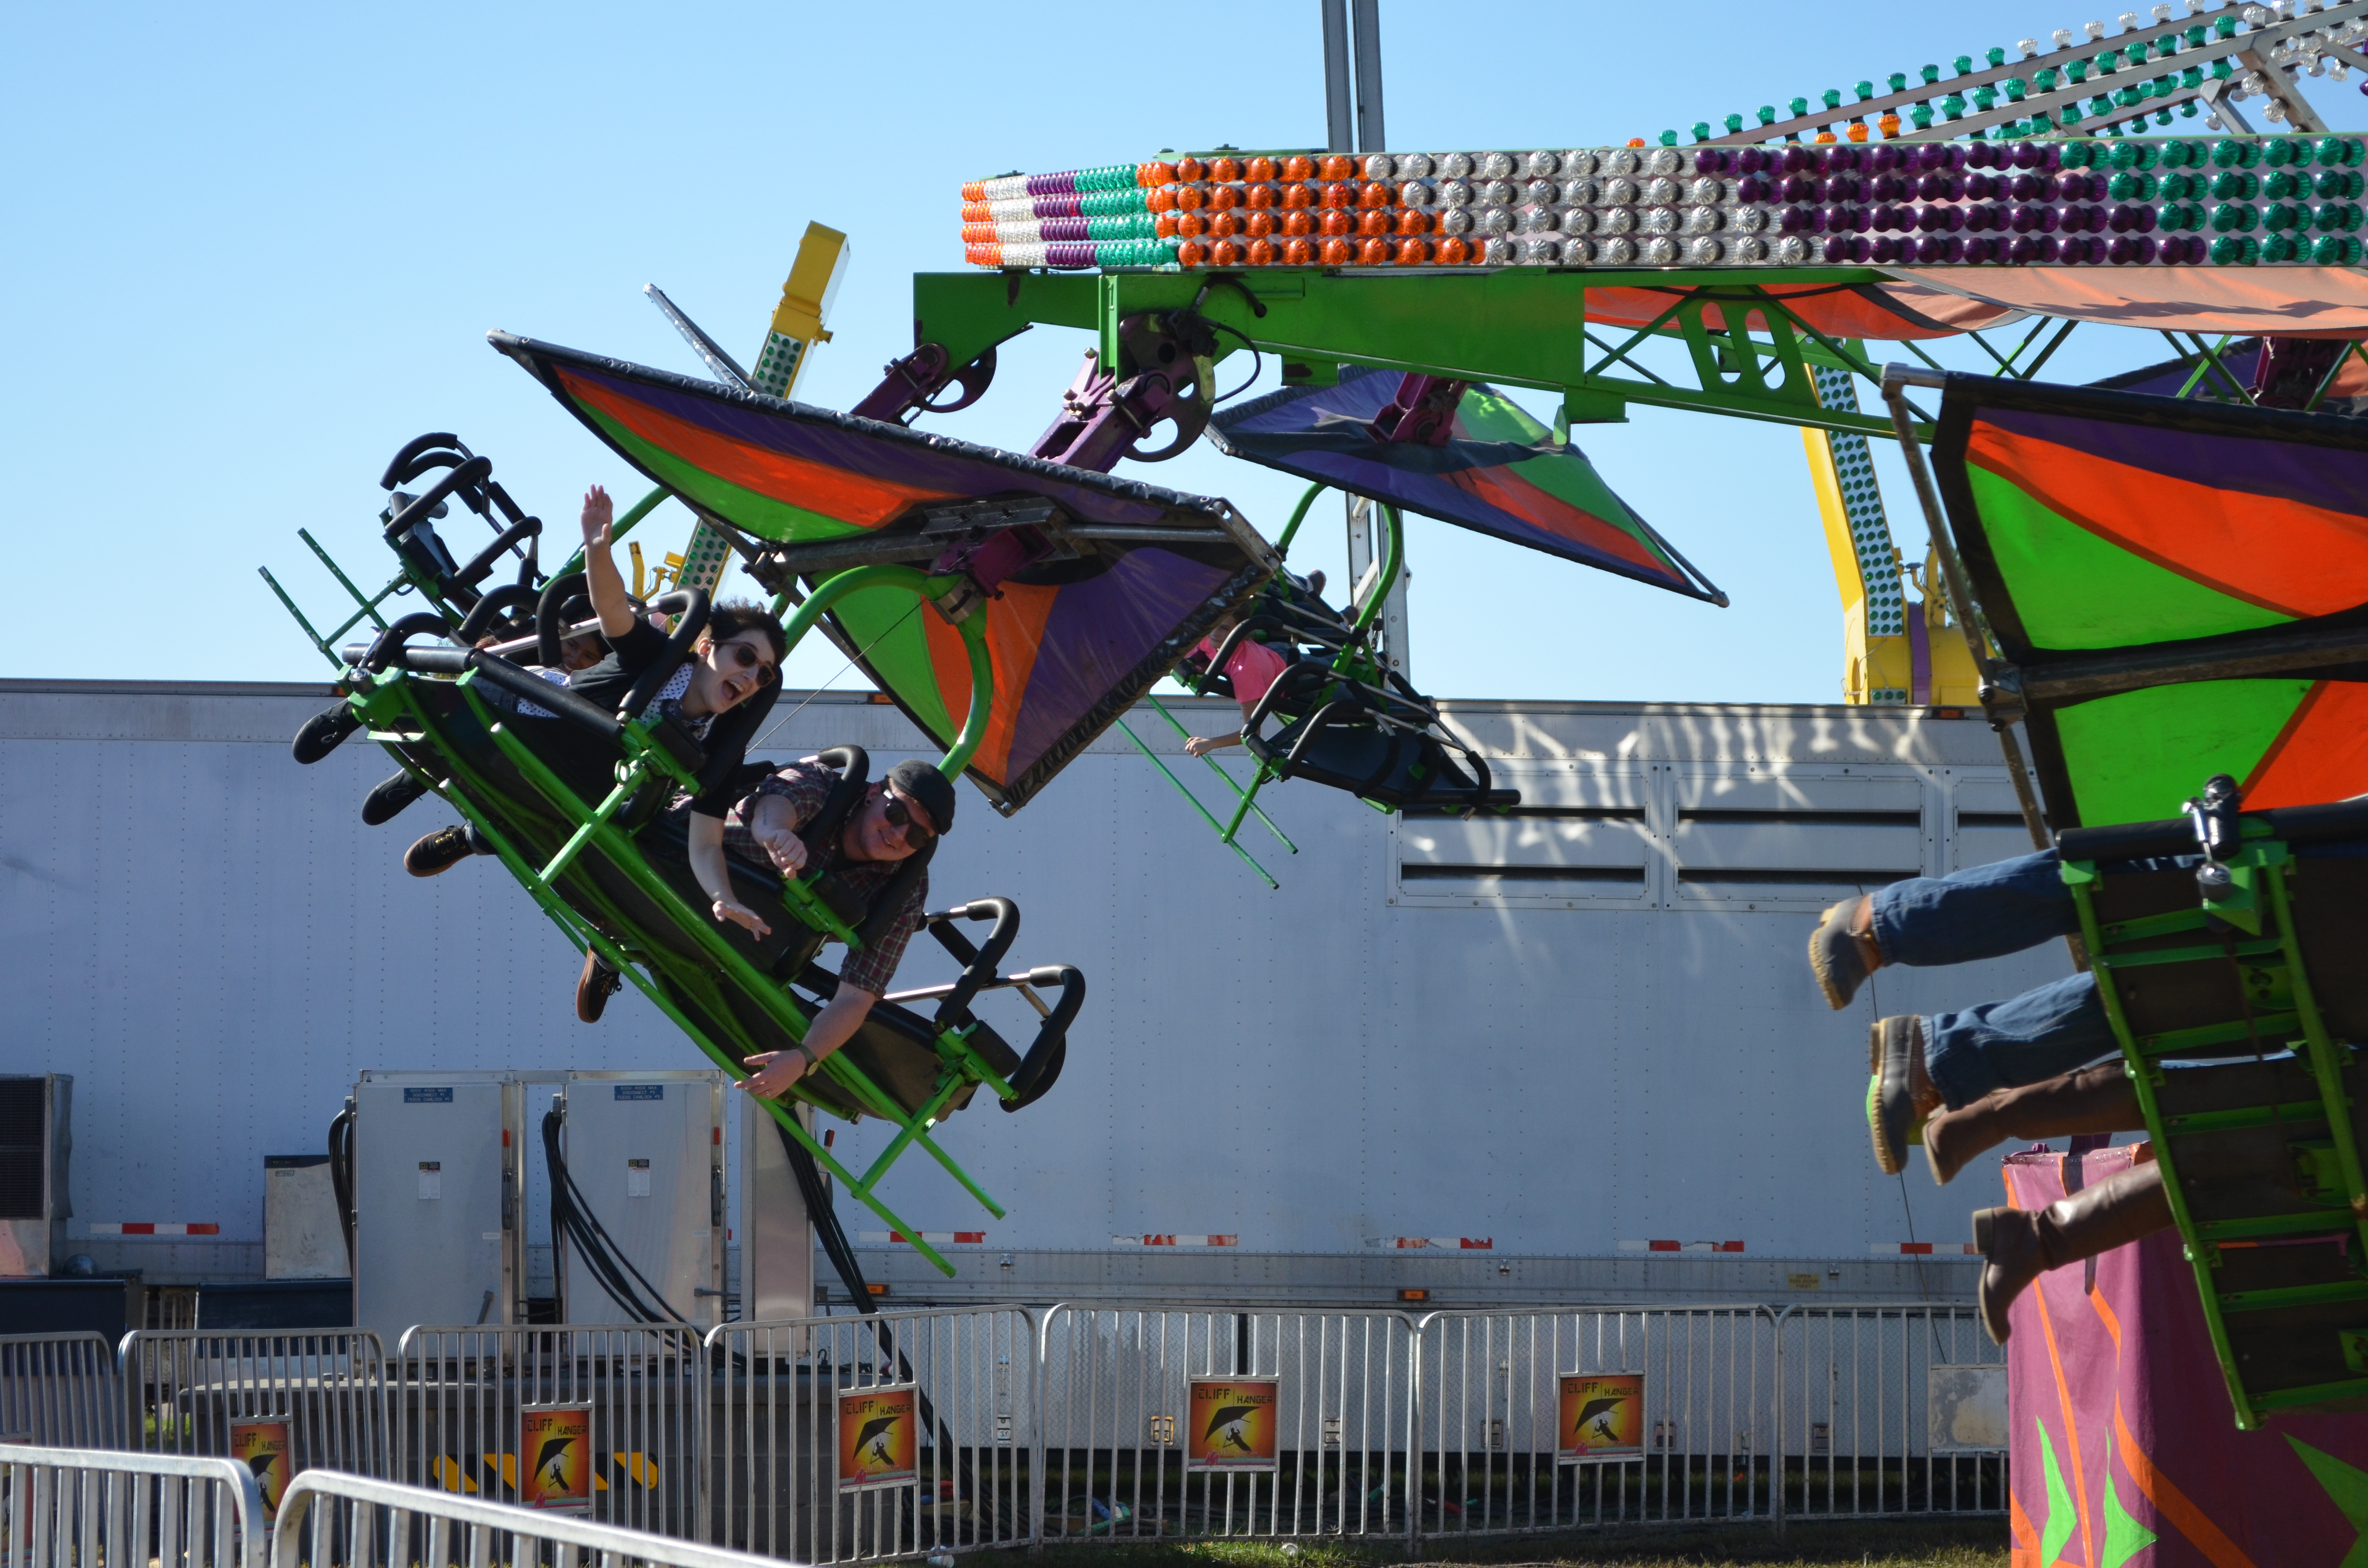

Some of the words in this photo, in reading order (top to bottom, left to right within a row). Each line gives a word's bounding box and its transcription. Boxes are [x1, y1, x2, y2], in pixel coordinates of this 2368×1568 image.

[1198, 1388, 1231, 1399] CLIFF
[1237, 1395, 1273, 1404] HANGER
[1567, 1382, 1599, 1394] CLIFF
[1604, 1387, 1639, 1396] HANGER
[846, 1400, 874, 1415] CLIFF
[880, 1404, 912, 1416] HANGER
[527, 1419, 553, 1432] CLIFF
[557, 1425, 587, 1436] HANGER
[234, 1433, 257, 1447] CLIFF
[261, 1440, 286, 1452] HANGER
